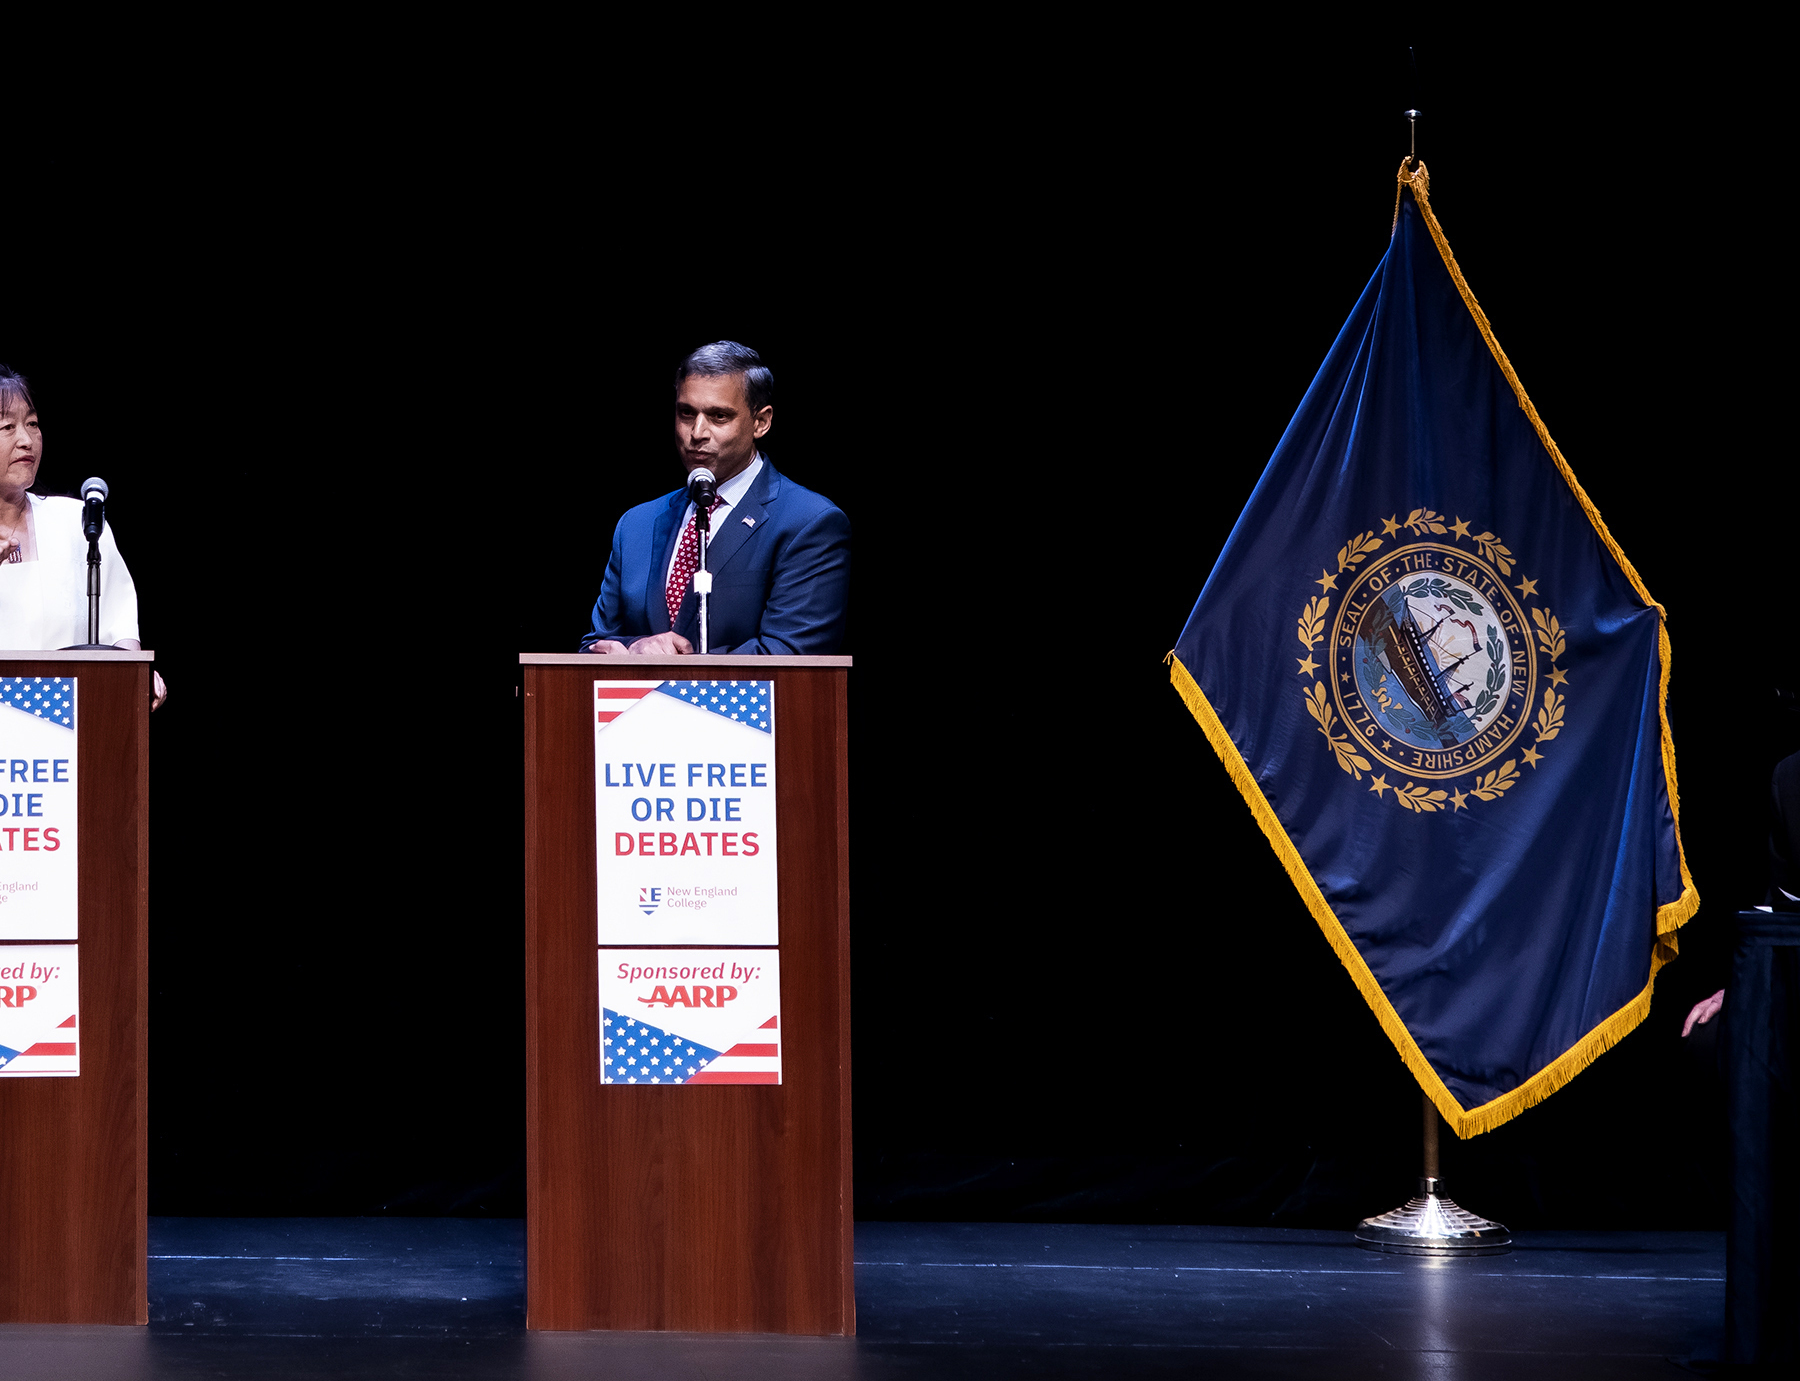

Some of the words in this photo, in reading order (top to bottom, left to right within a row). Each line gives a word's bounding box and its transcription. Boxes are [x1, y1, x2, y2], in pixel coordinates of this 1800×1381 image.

[1400, 553, 1432, 572] THE
[1368, 567, 1392, 593] OF
[1442, 557, 1498, 601] STATE
[1339, 599, 1368, 649] SEAL
[1500, 609, 1519, 639] OF
[1511, 649, 1527, 698] NEW
[1343, 691, 1377, 737] 1776
[1411, 713, 1515, 770] HAMPSHIRE
[605, 763, 676, 787] LIVE
[687, 763, 767, 787] FREE
[631, 797, 675, 822] OR
[686, 797, 742, 822] DIE
[615, 832, 760, 857] DEBATES
[667, 886, 692, 896] New
[694, 886, 738, 898] England
[667, 898, 707, 910] College
[30, 962, 60, 984] by:
[617, 962, 725, 984] Sponsored
[730, 962, 761, 984] by:
[637, 985, 738, 1008] AARP
